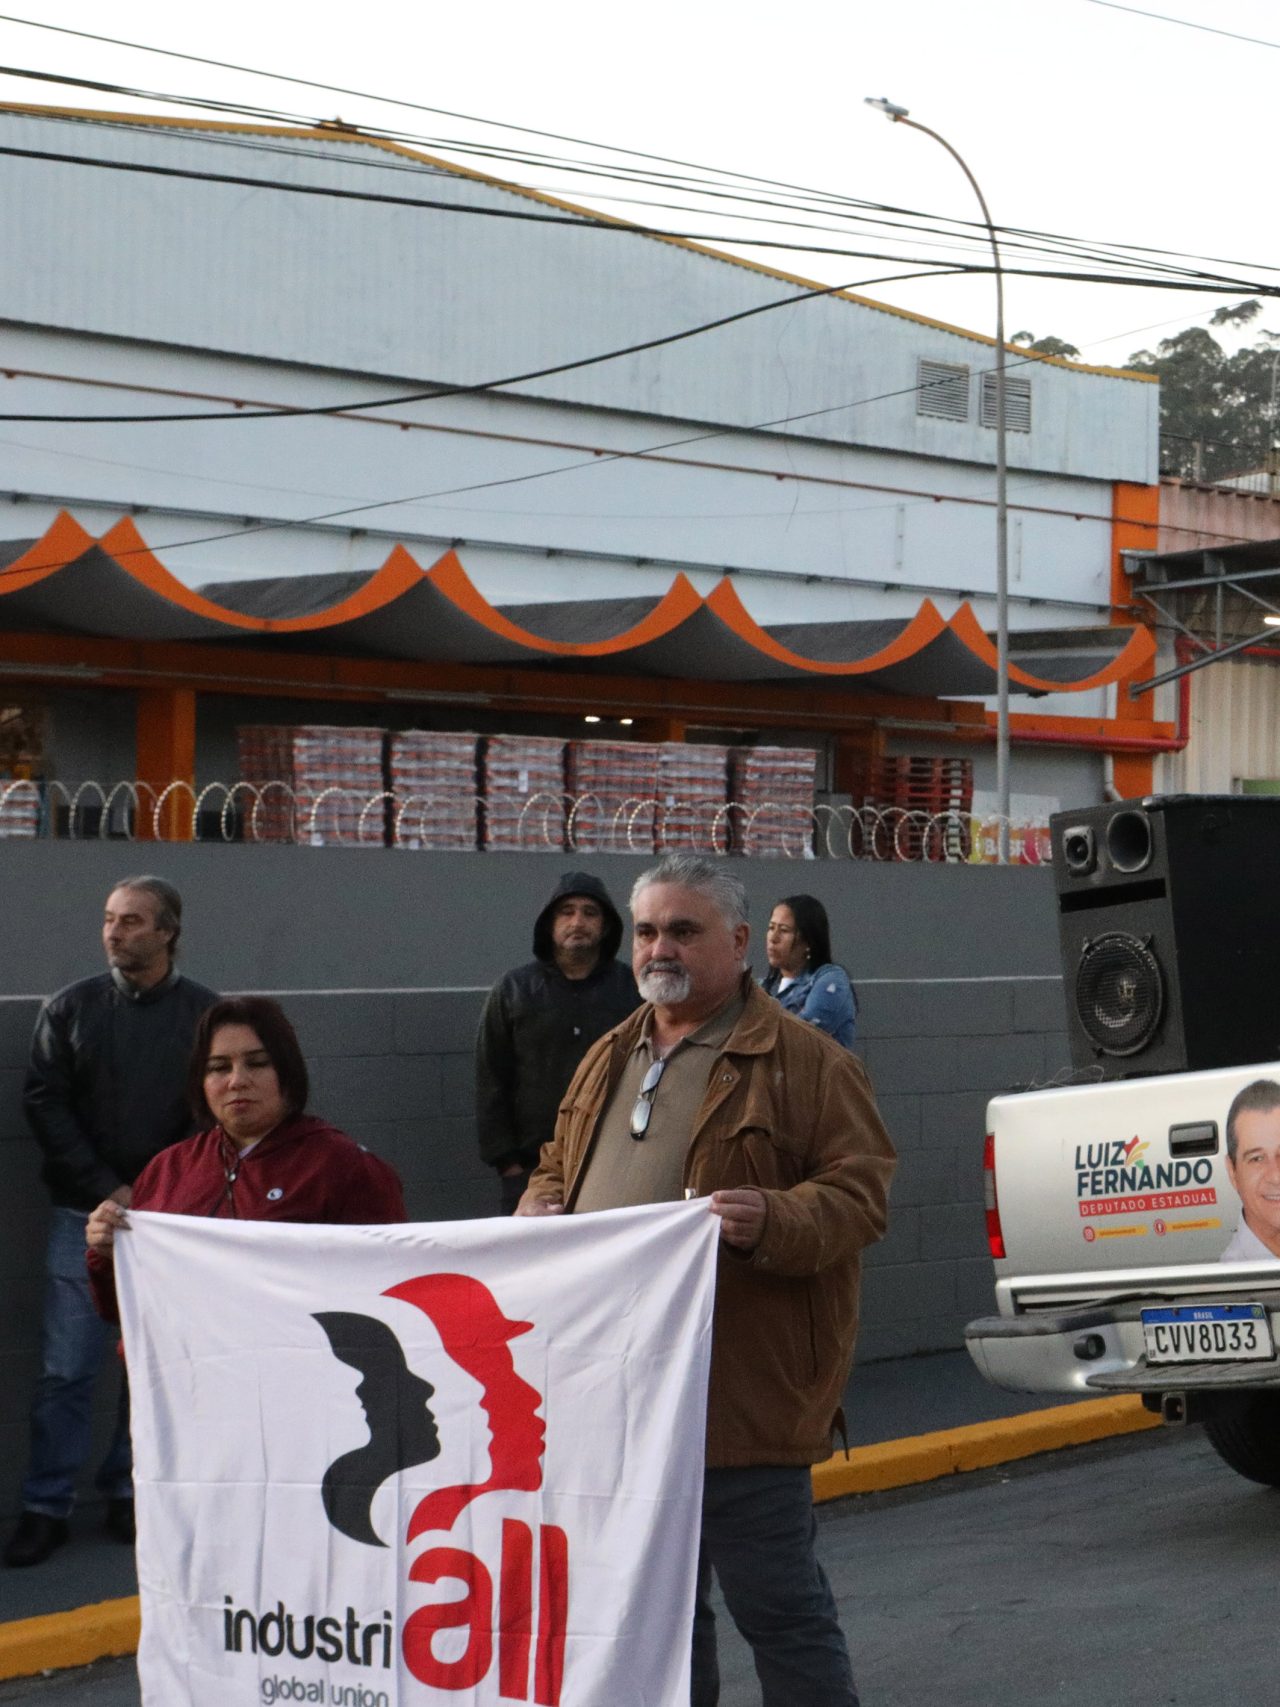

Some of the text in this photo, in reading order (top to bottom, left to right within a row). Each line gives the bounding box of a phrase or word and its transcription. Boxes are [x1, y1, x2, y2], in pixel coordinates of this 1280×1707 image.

[1075, 1141, 1125, 1170] LUIZ
[1077, 1158, 1213, 1197] FERNANDO
[1081, 1193, 1215, 1215] DEPUTADO ESTADUAL
[1193, 1311, 1214, 1319] BRASIL
[1154, 1321, 1257, 1353] CVV8D33
[262, 1675, 389, 1707] global union
